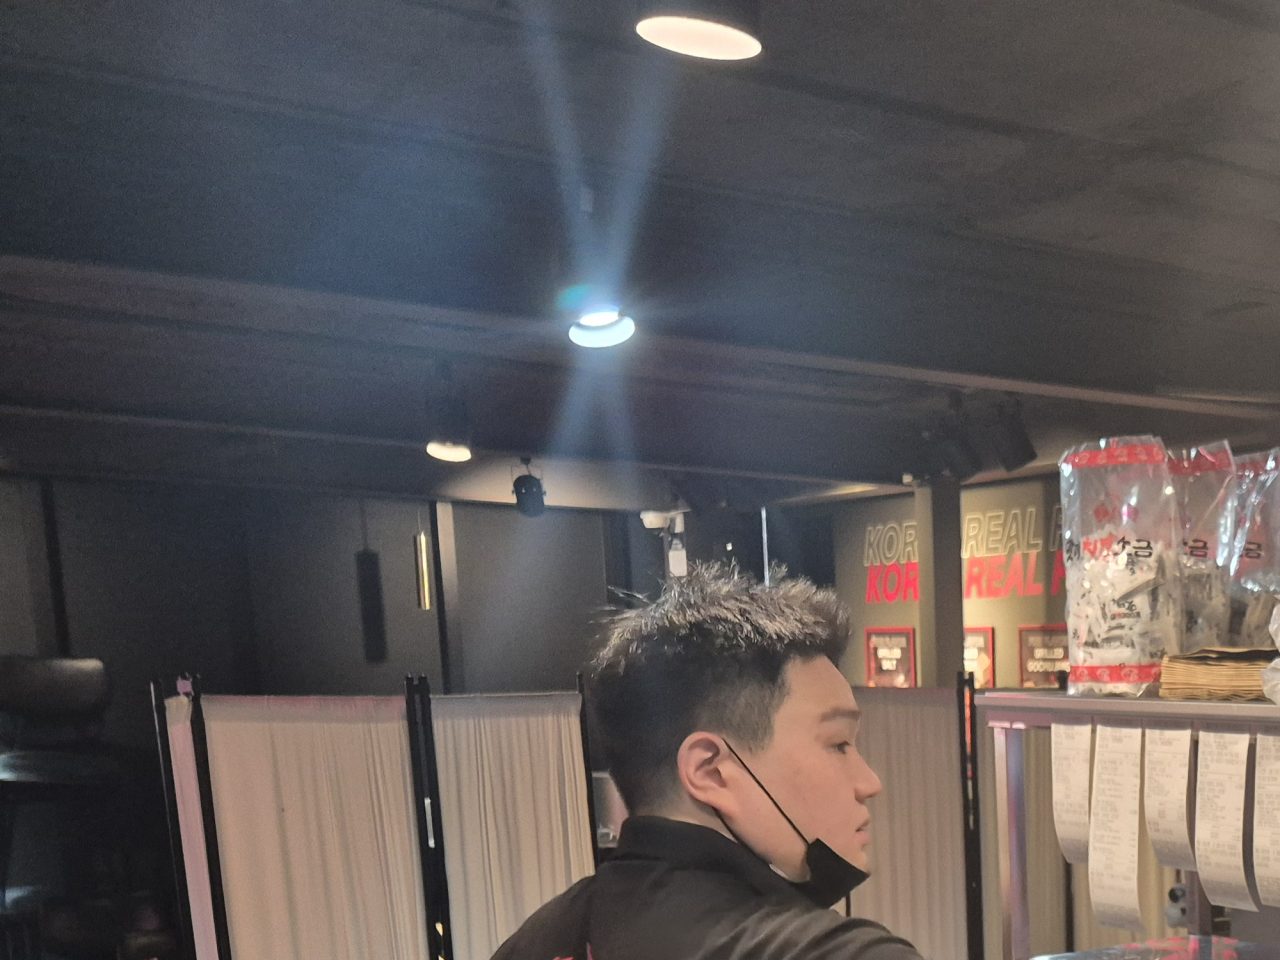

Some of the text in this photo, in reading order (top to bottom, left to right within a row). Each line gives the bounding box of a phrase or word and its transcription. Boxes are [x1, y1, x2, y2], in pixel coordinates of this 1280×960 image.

[864, 521, 919, 567] KOR
[961, 508, 1043, 558] REAL
[866, 560, 920, 604] KOR
